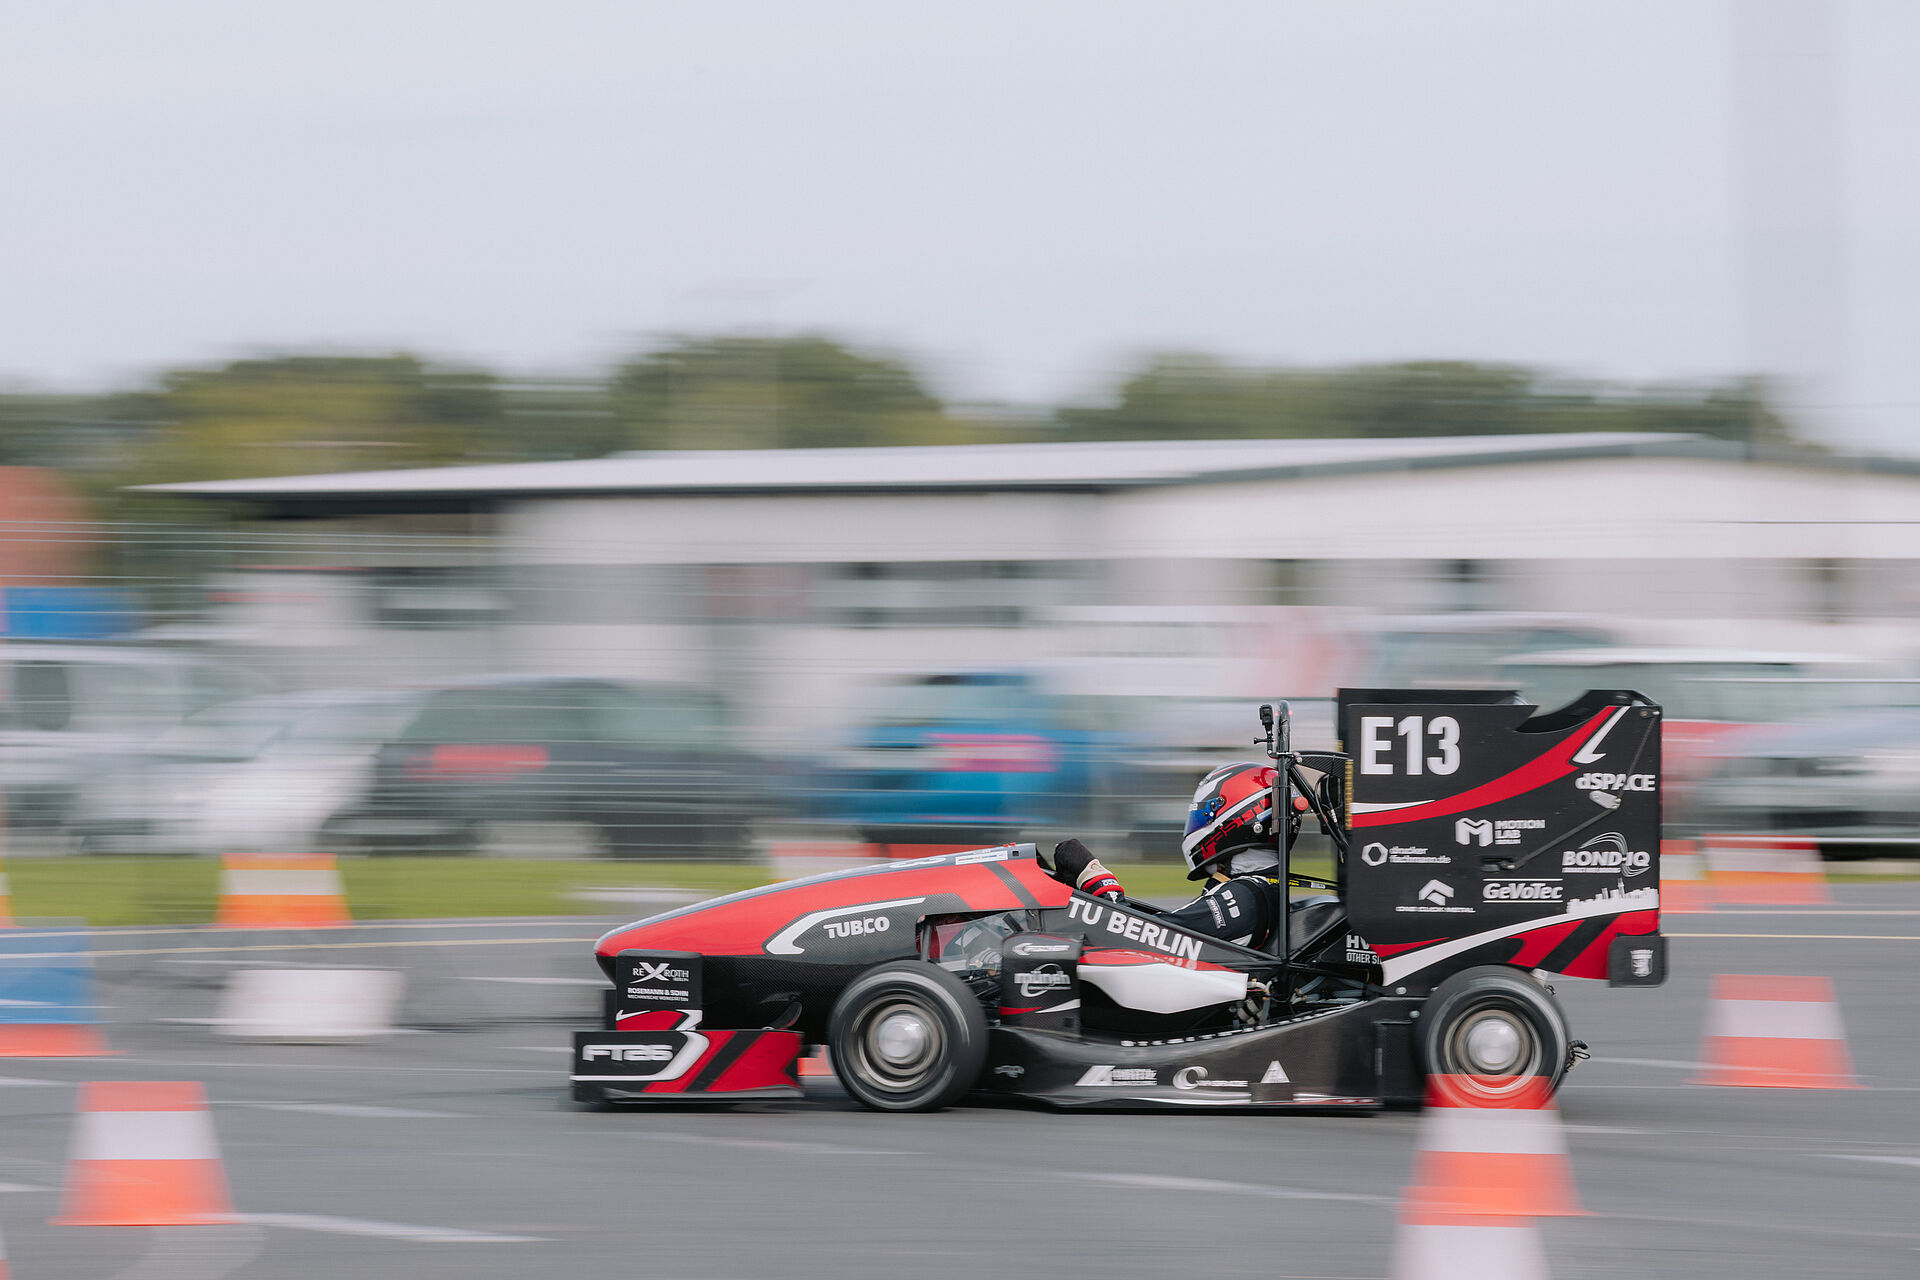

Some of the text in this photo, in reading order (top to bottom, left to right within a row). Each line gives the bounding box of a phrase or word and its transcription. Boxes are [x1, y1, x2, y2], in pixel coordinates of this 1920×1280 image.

[1360, 715, 1461, 776] E13
[1575, 772, 1656, 791] dSPACE
[1495, 820, 1545, 829] MOTION
[1495, 829, 1521, 839] LAB
[1562, 851, 1650, 867] BOND-IQ
[1482, 882, 1563, 899] GeVoTec
[1069, 896, 1104, 925] TU
[1107, 911, 1204, 961] BERLIN
[1346, 952, 1371, 964] OTHER
